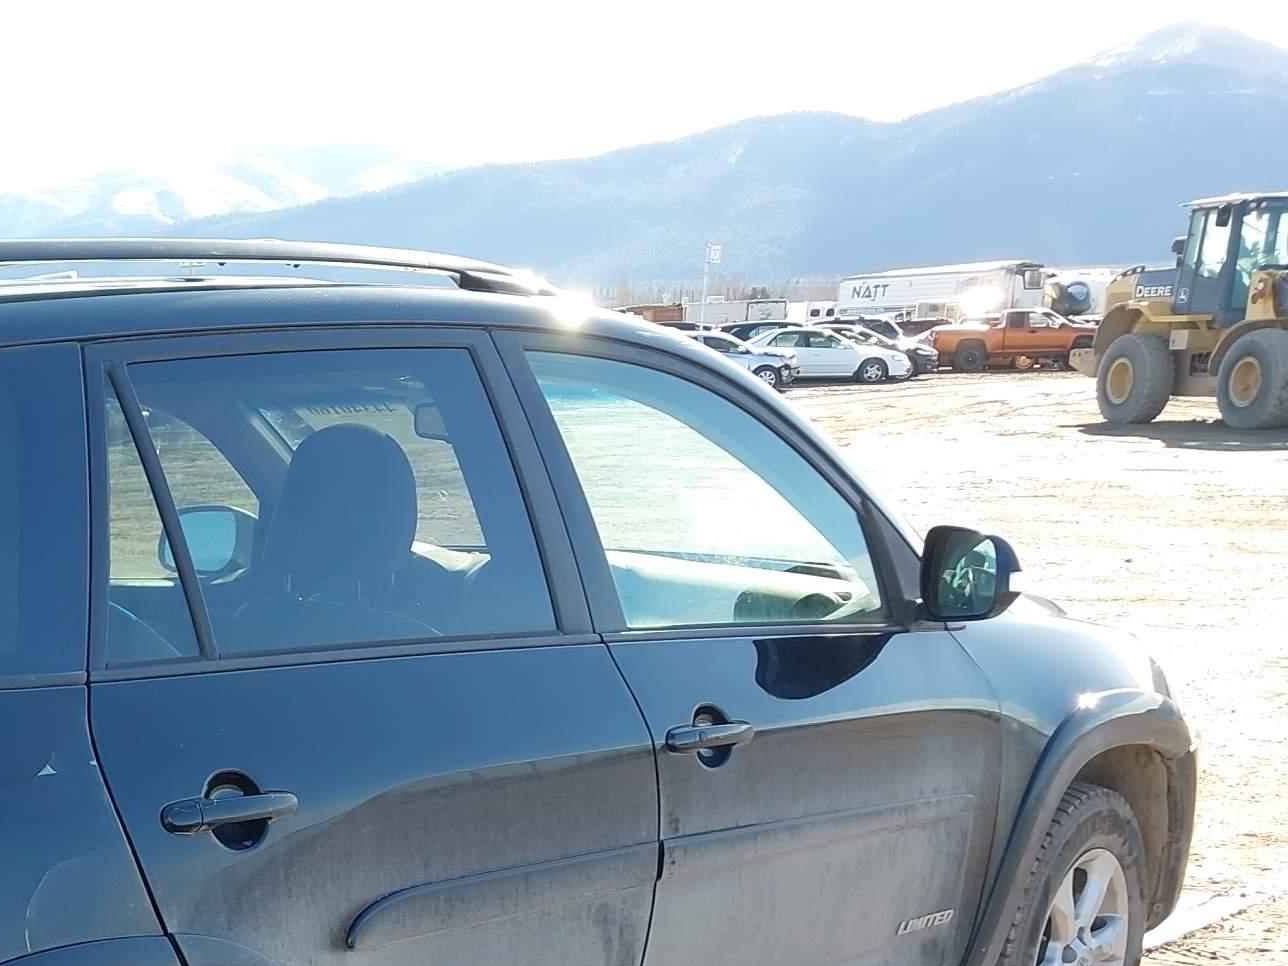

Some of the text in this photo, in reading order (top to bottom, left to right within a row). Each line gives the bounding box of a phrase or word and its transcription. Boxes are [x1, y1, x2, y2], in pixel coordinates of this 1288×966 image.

[851, 283, 890, 301] NATT
[1135, 285, 1173, 298] DEERE
[897, 909, 954, 935] LIMITED
